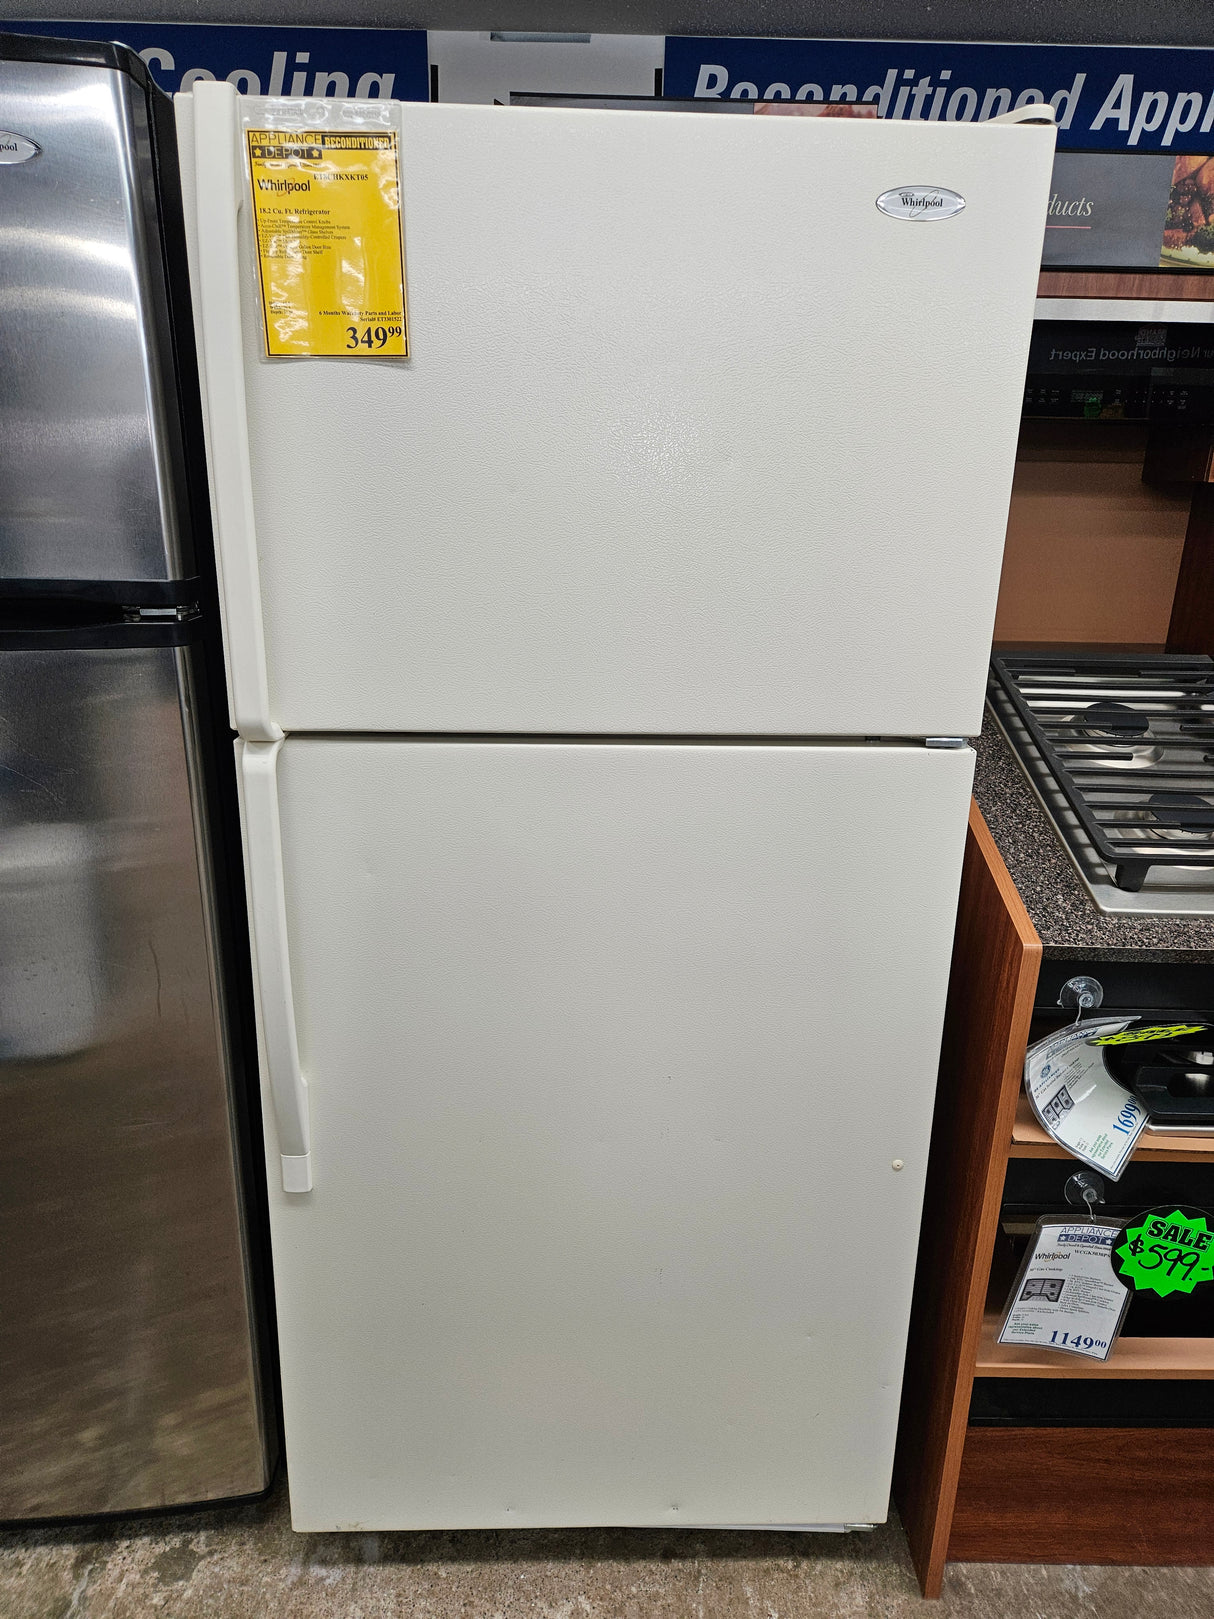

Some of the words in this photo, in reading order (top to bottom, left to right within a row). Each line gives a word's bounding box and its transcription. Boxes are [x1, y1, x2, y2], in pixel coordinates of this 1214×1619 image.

[251, 134, 321, 144] APPLIANCE
[324, 136, 390, 150] RECONDITIONED
[265, 147, 308, 158] DEPOT
[257, 179, 311, 194] Whirlpool
[902, 197, 943, 208] Whirlpool
[1060, 1227, 1118, 1238] APPLIANCE
[1147, 1220, 1214, 1252] SALE
[1068, 1234, 1104, 1244] DEPOT
[1035, 1252, 1071, 1260] Whirlpool
